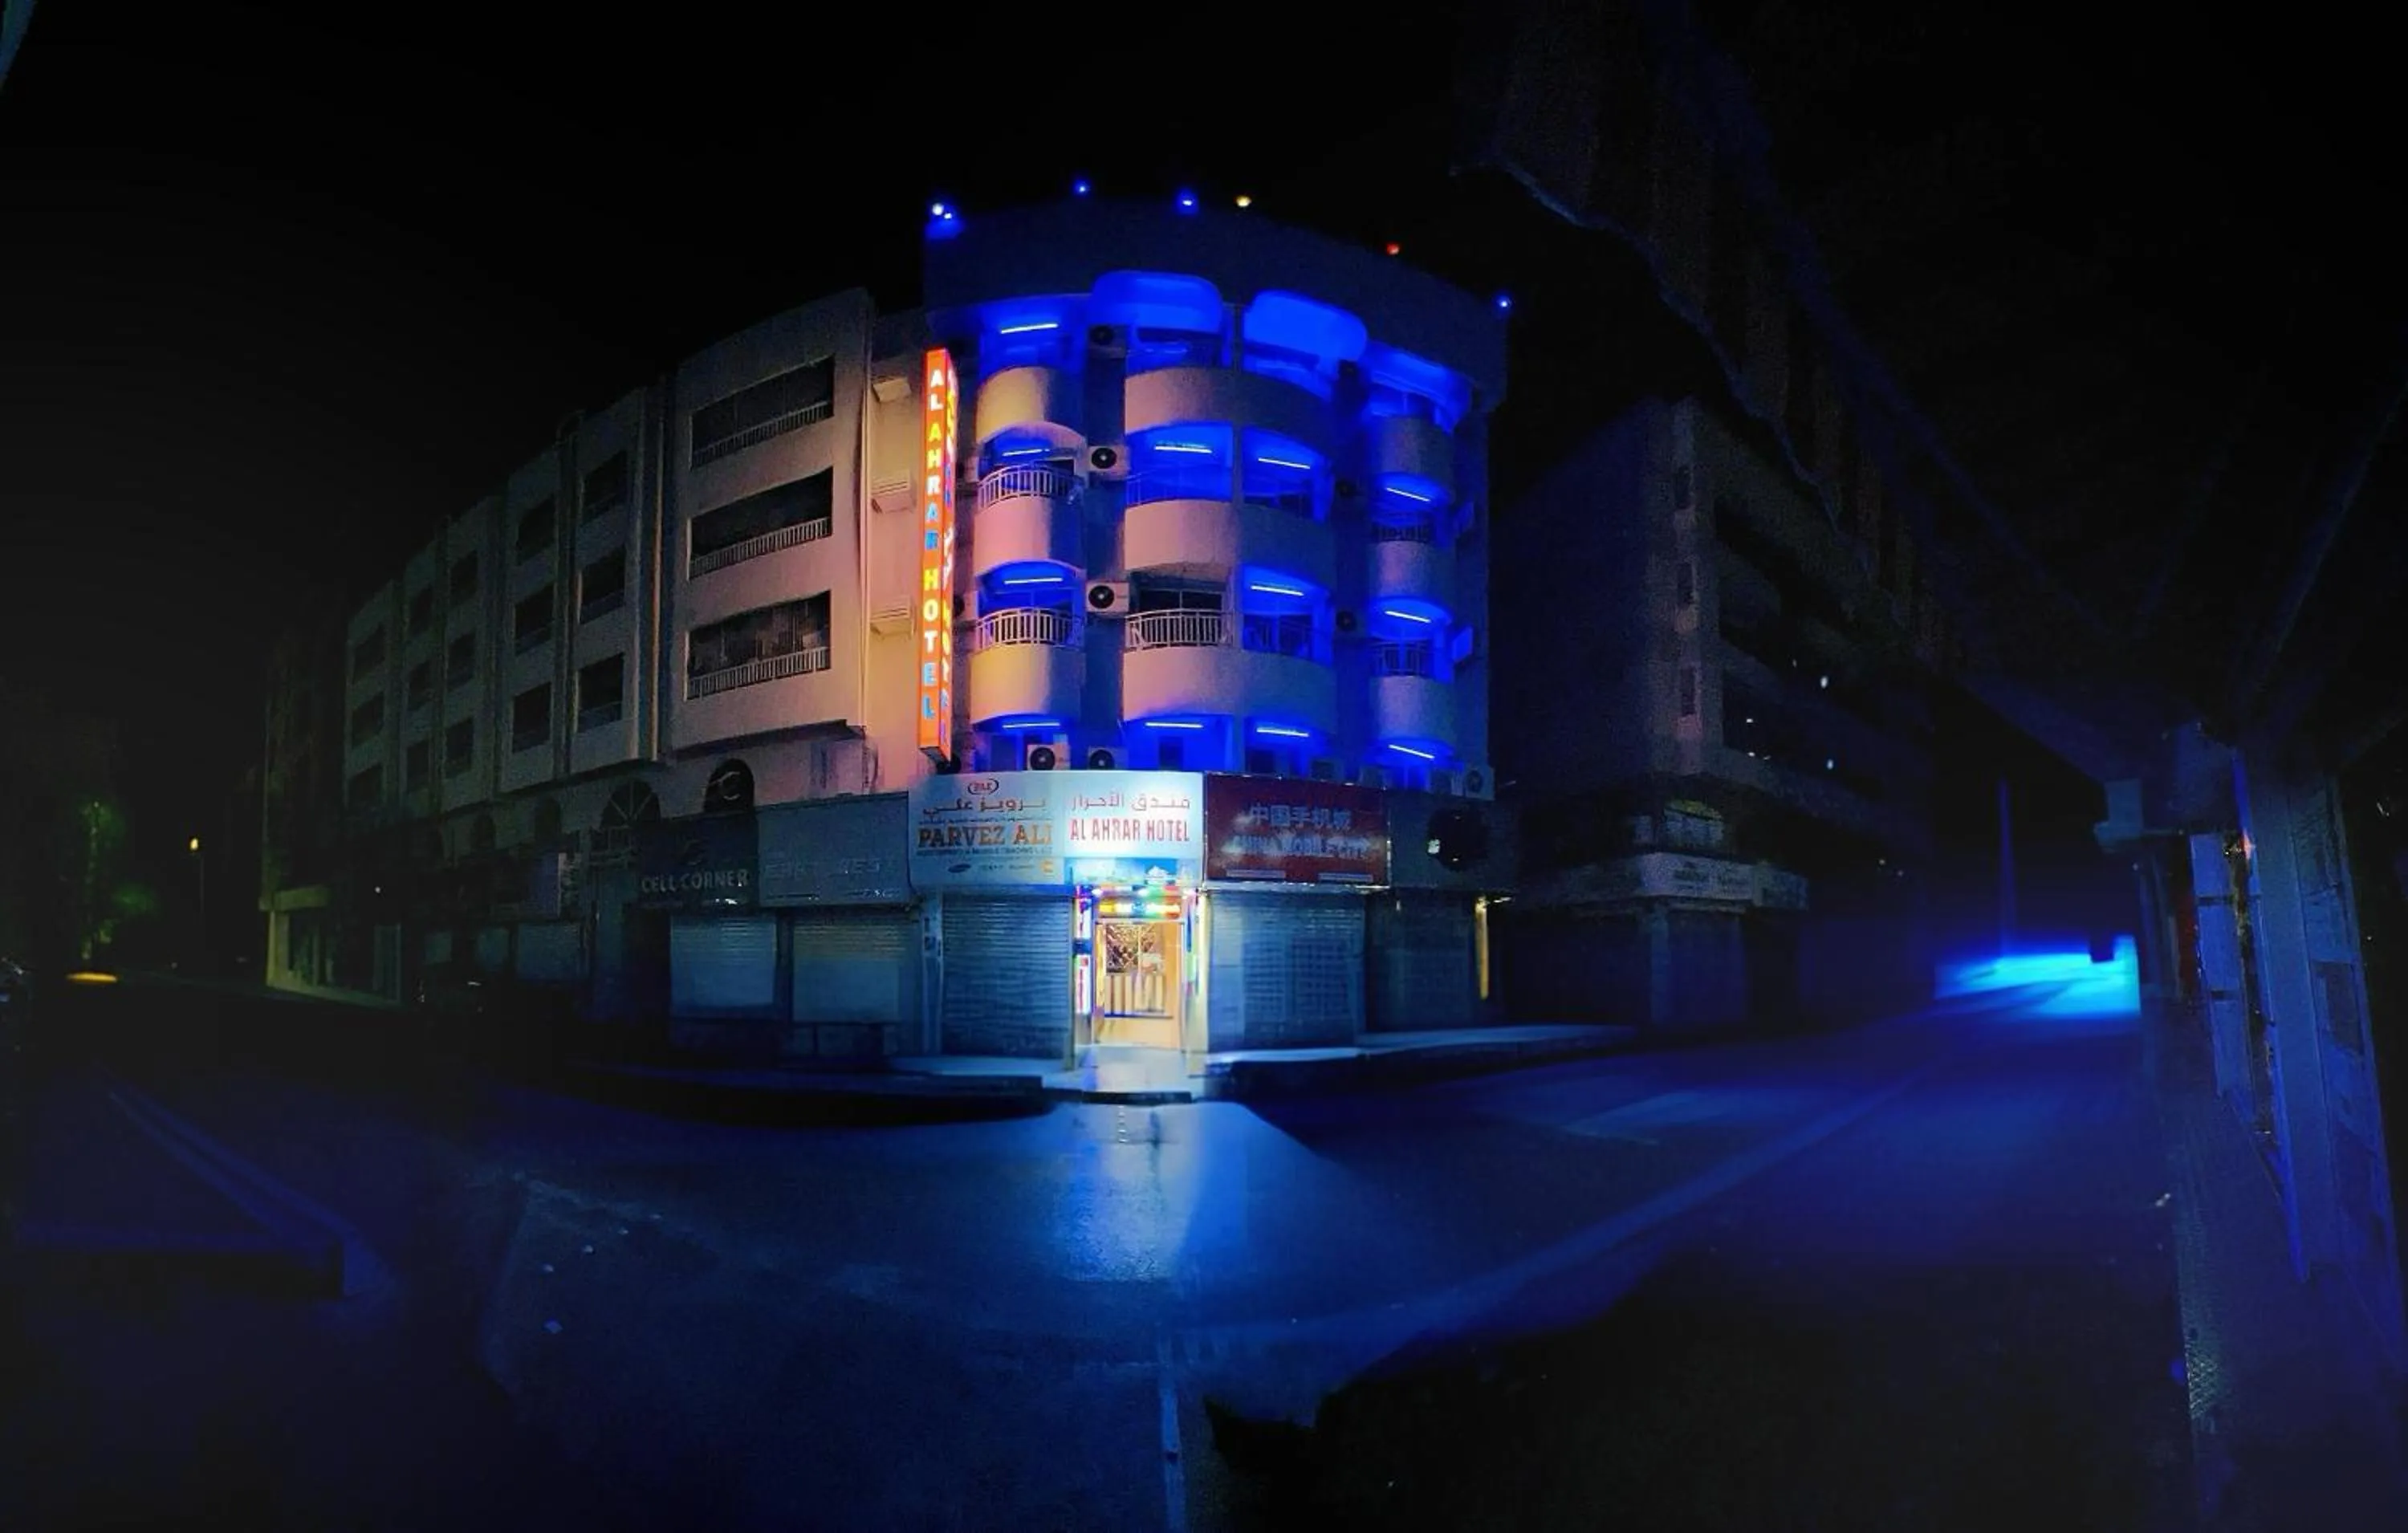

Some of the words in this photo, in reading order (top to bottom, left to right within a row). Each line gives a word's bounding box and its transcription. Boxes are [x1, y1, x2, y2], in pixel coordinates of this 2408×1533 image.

[929, 368, 945, 411] AL
[922, 567, 940, 719] HOTEL
[917, 825, 1007, 848] PARVEZ
[1013, 824, 1053, 846] ALI
[1070, 818, 1087, 841] AL
[1091, 818, 1141, 841] AHRAR
[1146, 819, 1190, 842] HOTEL
[641, 876, 677, 893] CELL
[681, 868, 749, 889] CORNER
